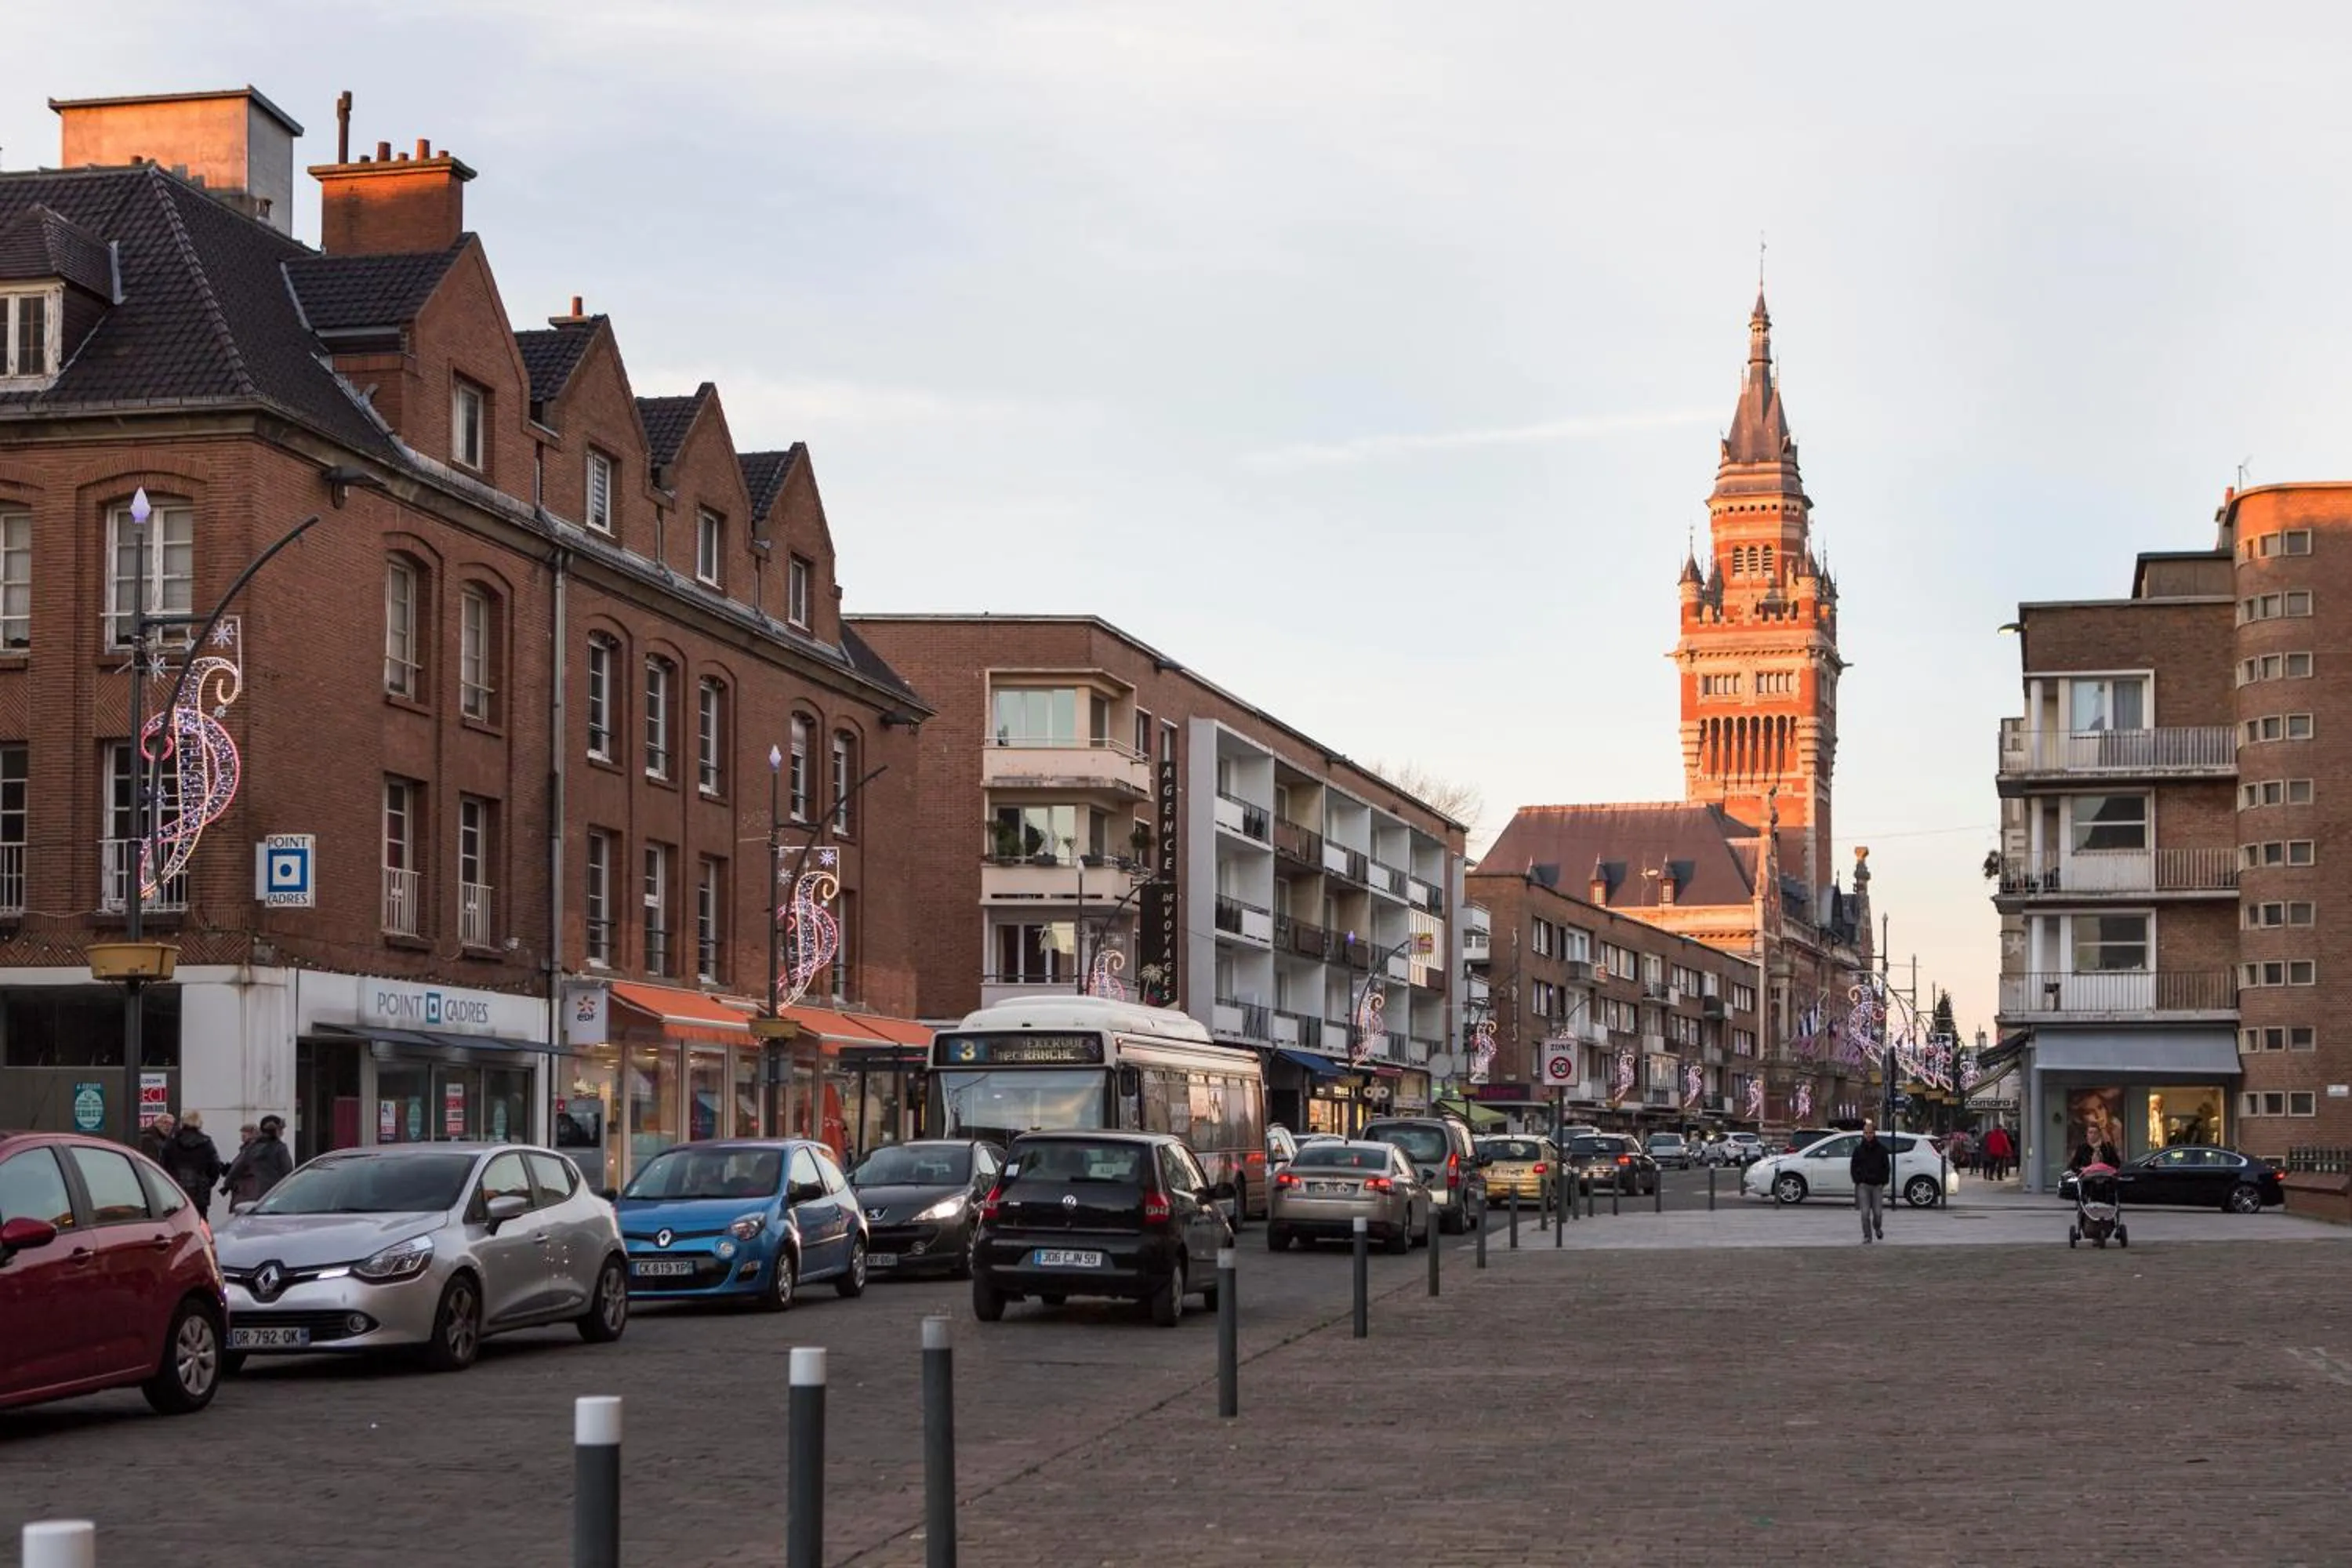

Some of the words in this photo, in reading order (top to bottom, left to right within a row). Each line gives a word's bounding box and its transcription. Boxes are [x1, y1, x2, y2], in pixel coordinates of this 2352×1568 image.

[1162, 766, 1174, 870] AGENCE
[267, 837, 307, 848] POINT
[267, 893, 308, 905] CADRES
[1163, 893, 1174, 902] DE
[1163, 906, 1172, 1000] VOYAGES
[377, 992, 422, 1018] POINT
[445, 998, 488, 1023] CADRES
[960, 1040, 976, 1061] 3
[1555, 1062, 1567, 1073] 30
